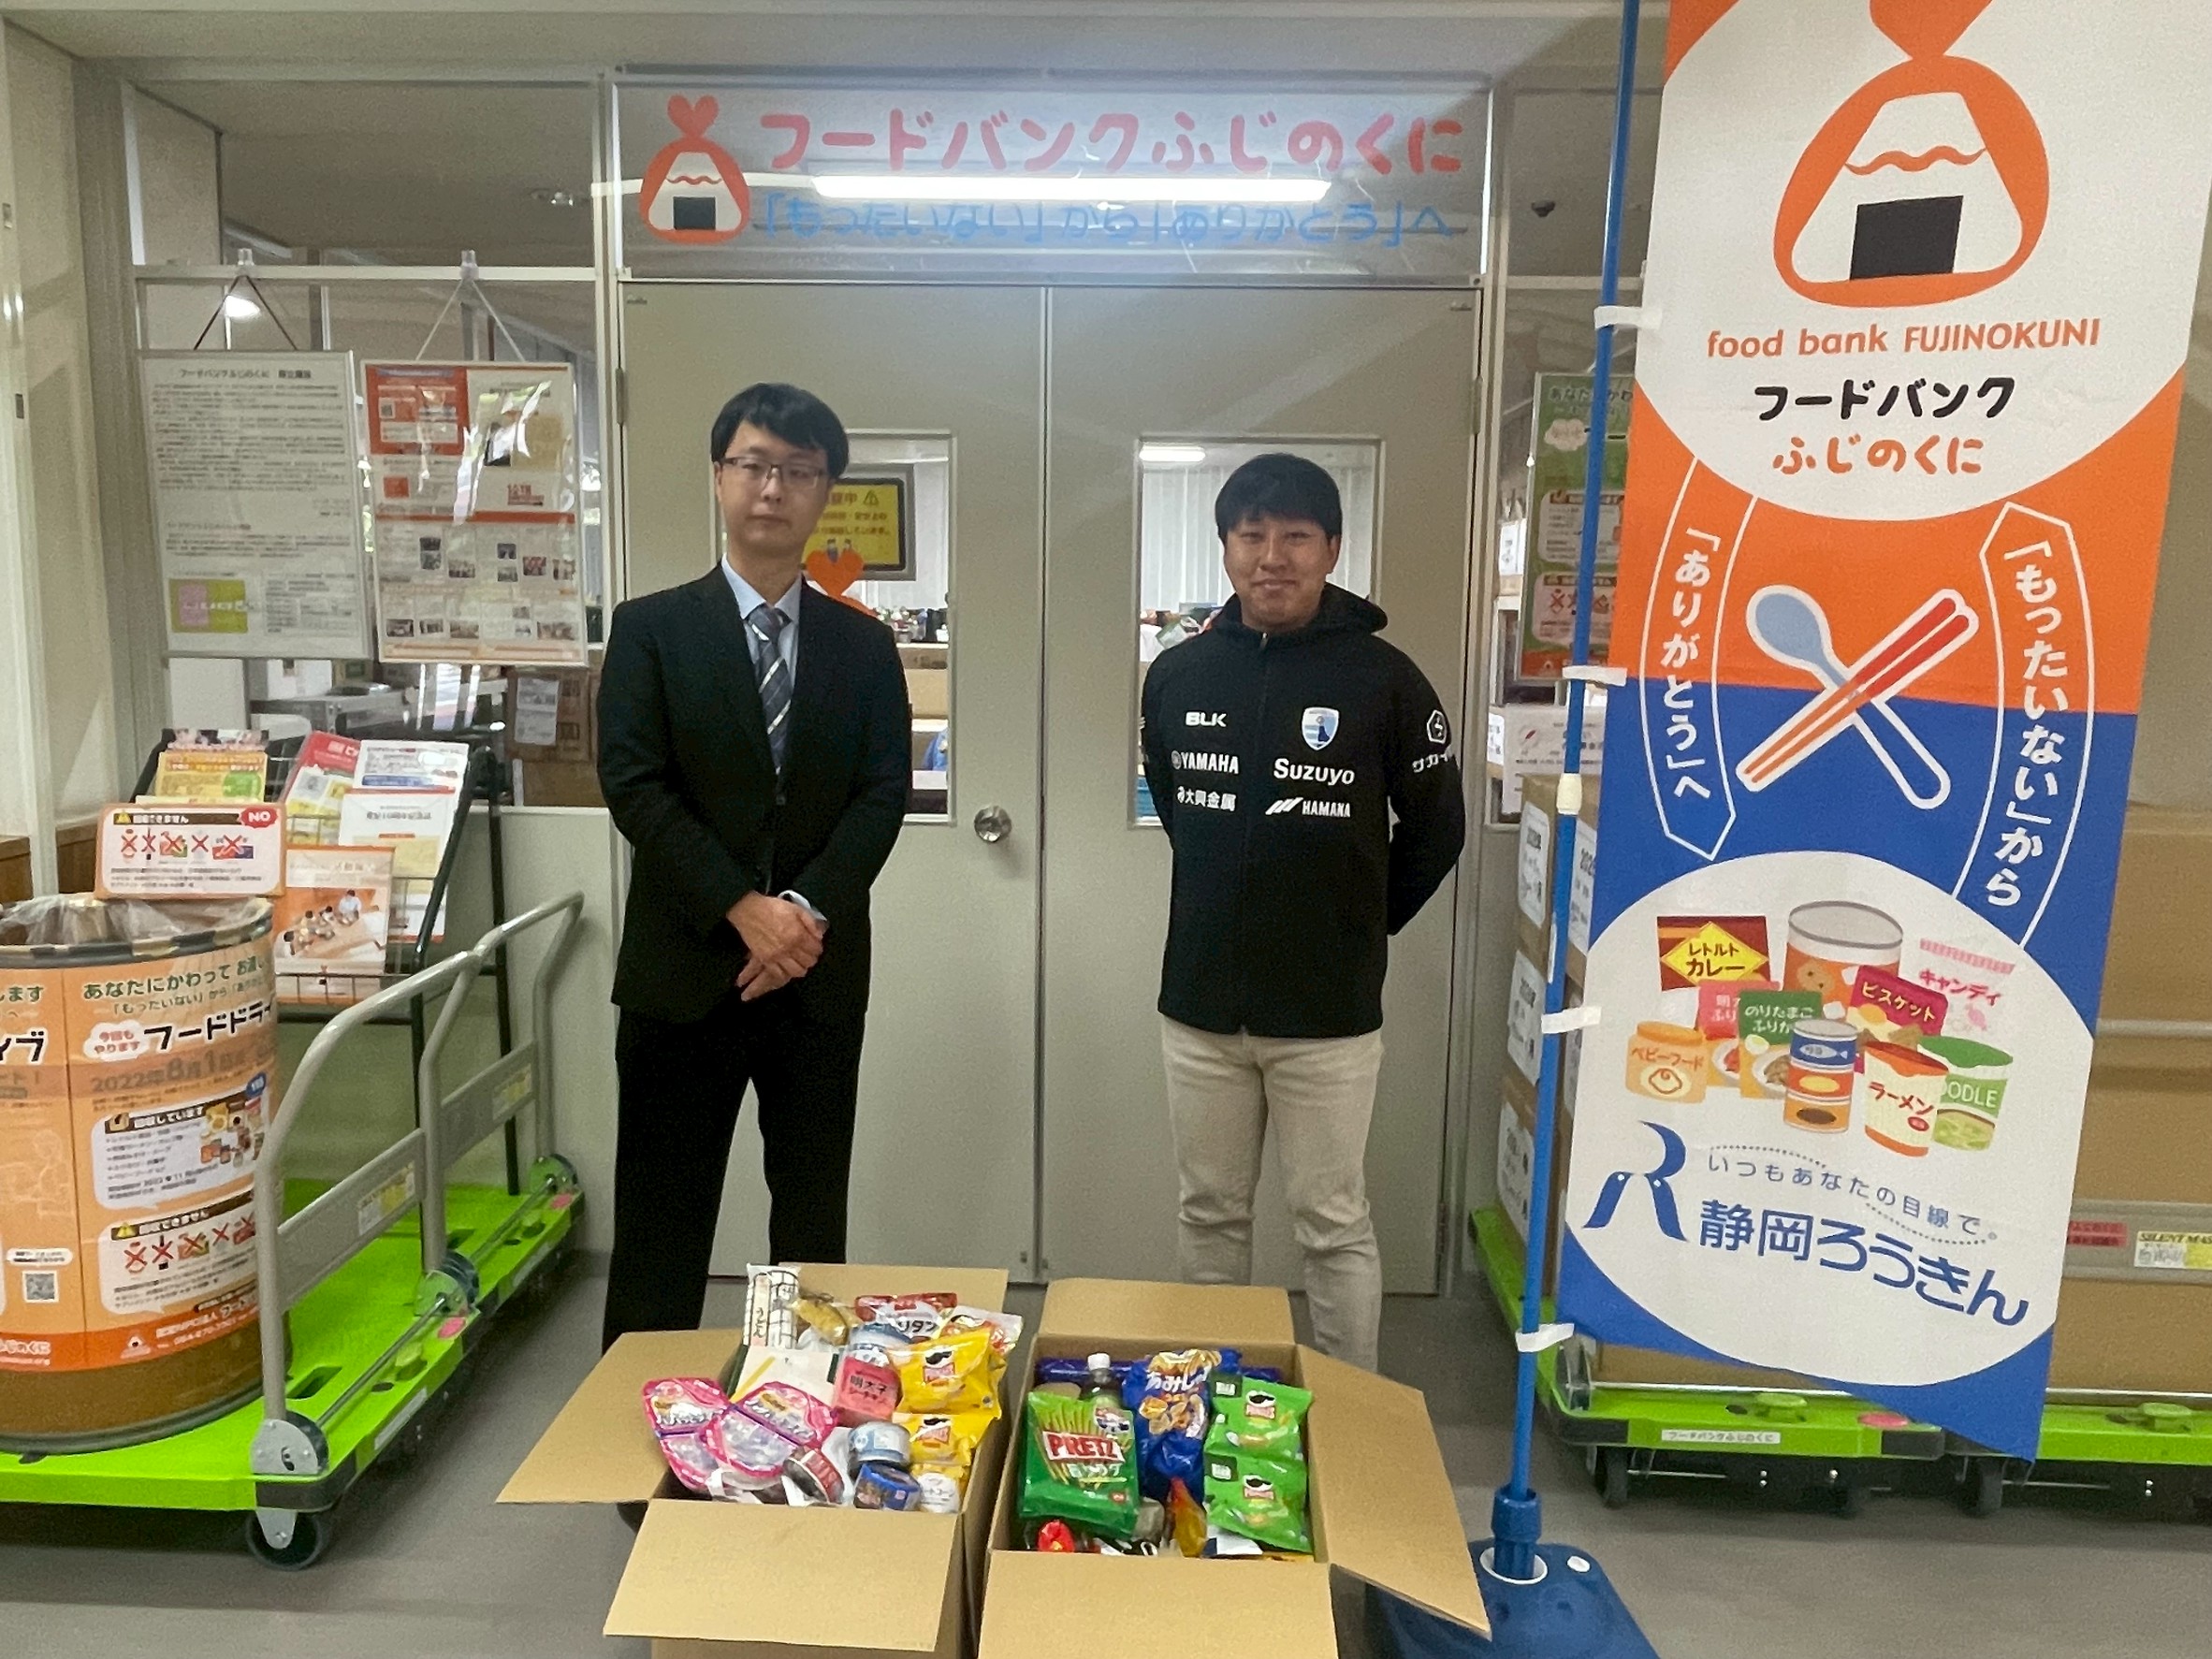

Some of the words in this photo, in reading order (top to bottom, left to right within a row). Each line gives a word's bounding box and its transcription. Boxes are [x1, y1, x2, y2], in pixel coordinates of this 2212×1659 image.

[761, 109, 1463, 175] フードバンクふじのくに
[1707, 329, 1784, 357] food
[1798, 325, 1888, 355] bank
[1903, 317, 2101, 353] FUJINOKUNI
[1754, 376, 2016, 421] フードバンク
[1771, 434, 1984, 475] ふじのくに
[1661, 527, 1721, 799] 「ありがとう」へ
[1185, 711, 1227, 727] BLK
[1985, 540, 2069, 906] 「もったいない」から
[1180, 751, 1239, 775] YAMAHA
[1273, 757, 1355, 786] Suzuyo
[248, 810, 271, 822] NO
[1684, 957, 1745, 977] カレー
[1688, 942, 1739, 957] レトルト
[84, 965, 231, 999] あなたにかわって
[1919, 968, 2001, 1007] キャンディ
[1861, 982, 1936, 1023] ビスケット
[1631, 1046, 1705, 1070] ベビーフード
[1868, 1081, 1934, 1116] ラーメン
[1698, 1199, 2030, 1327] 静岡ろうきん
